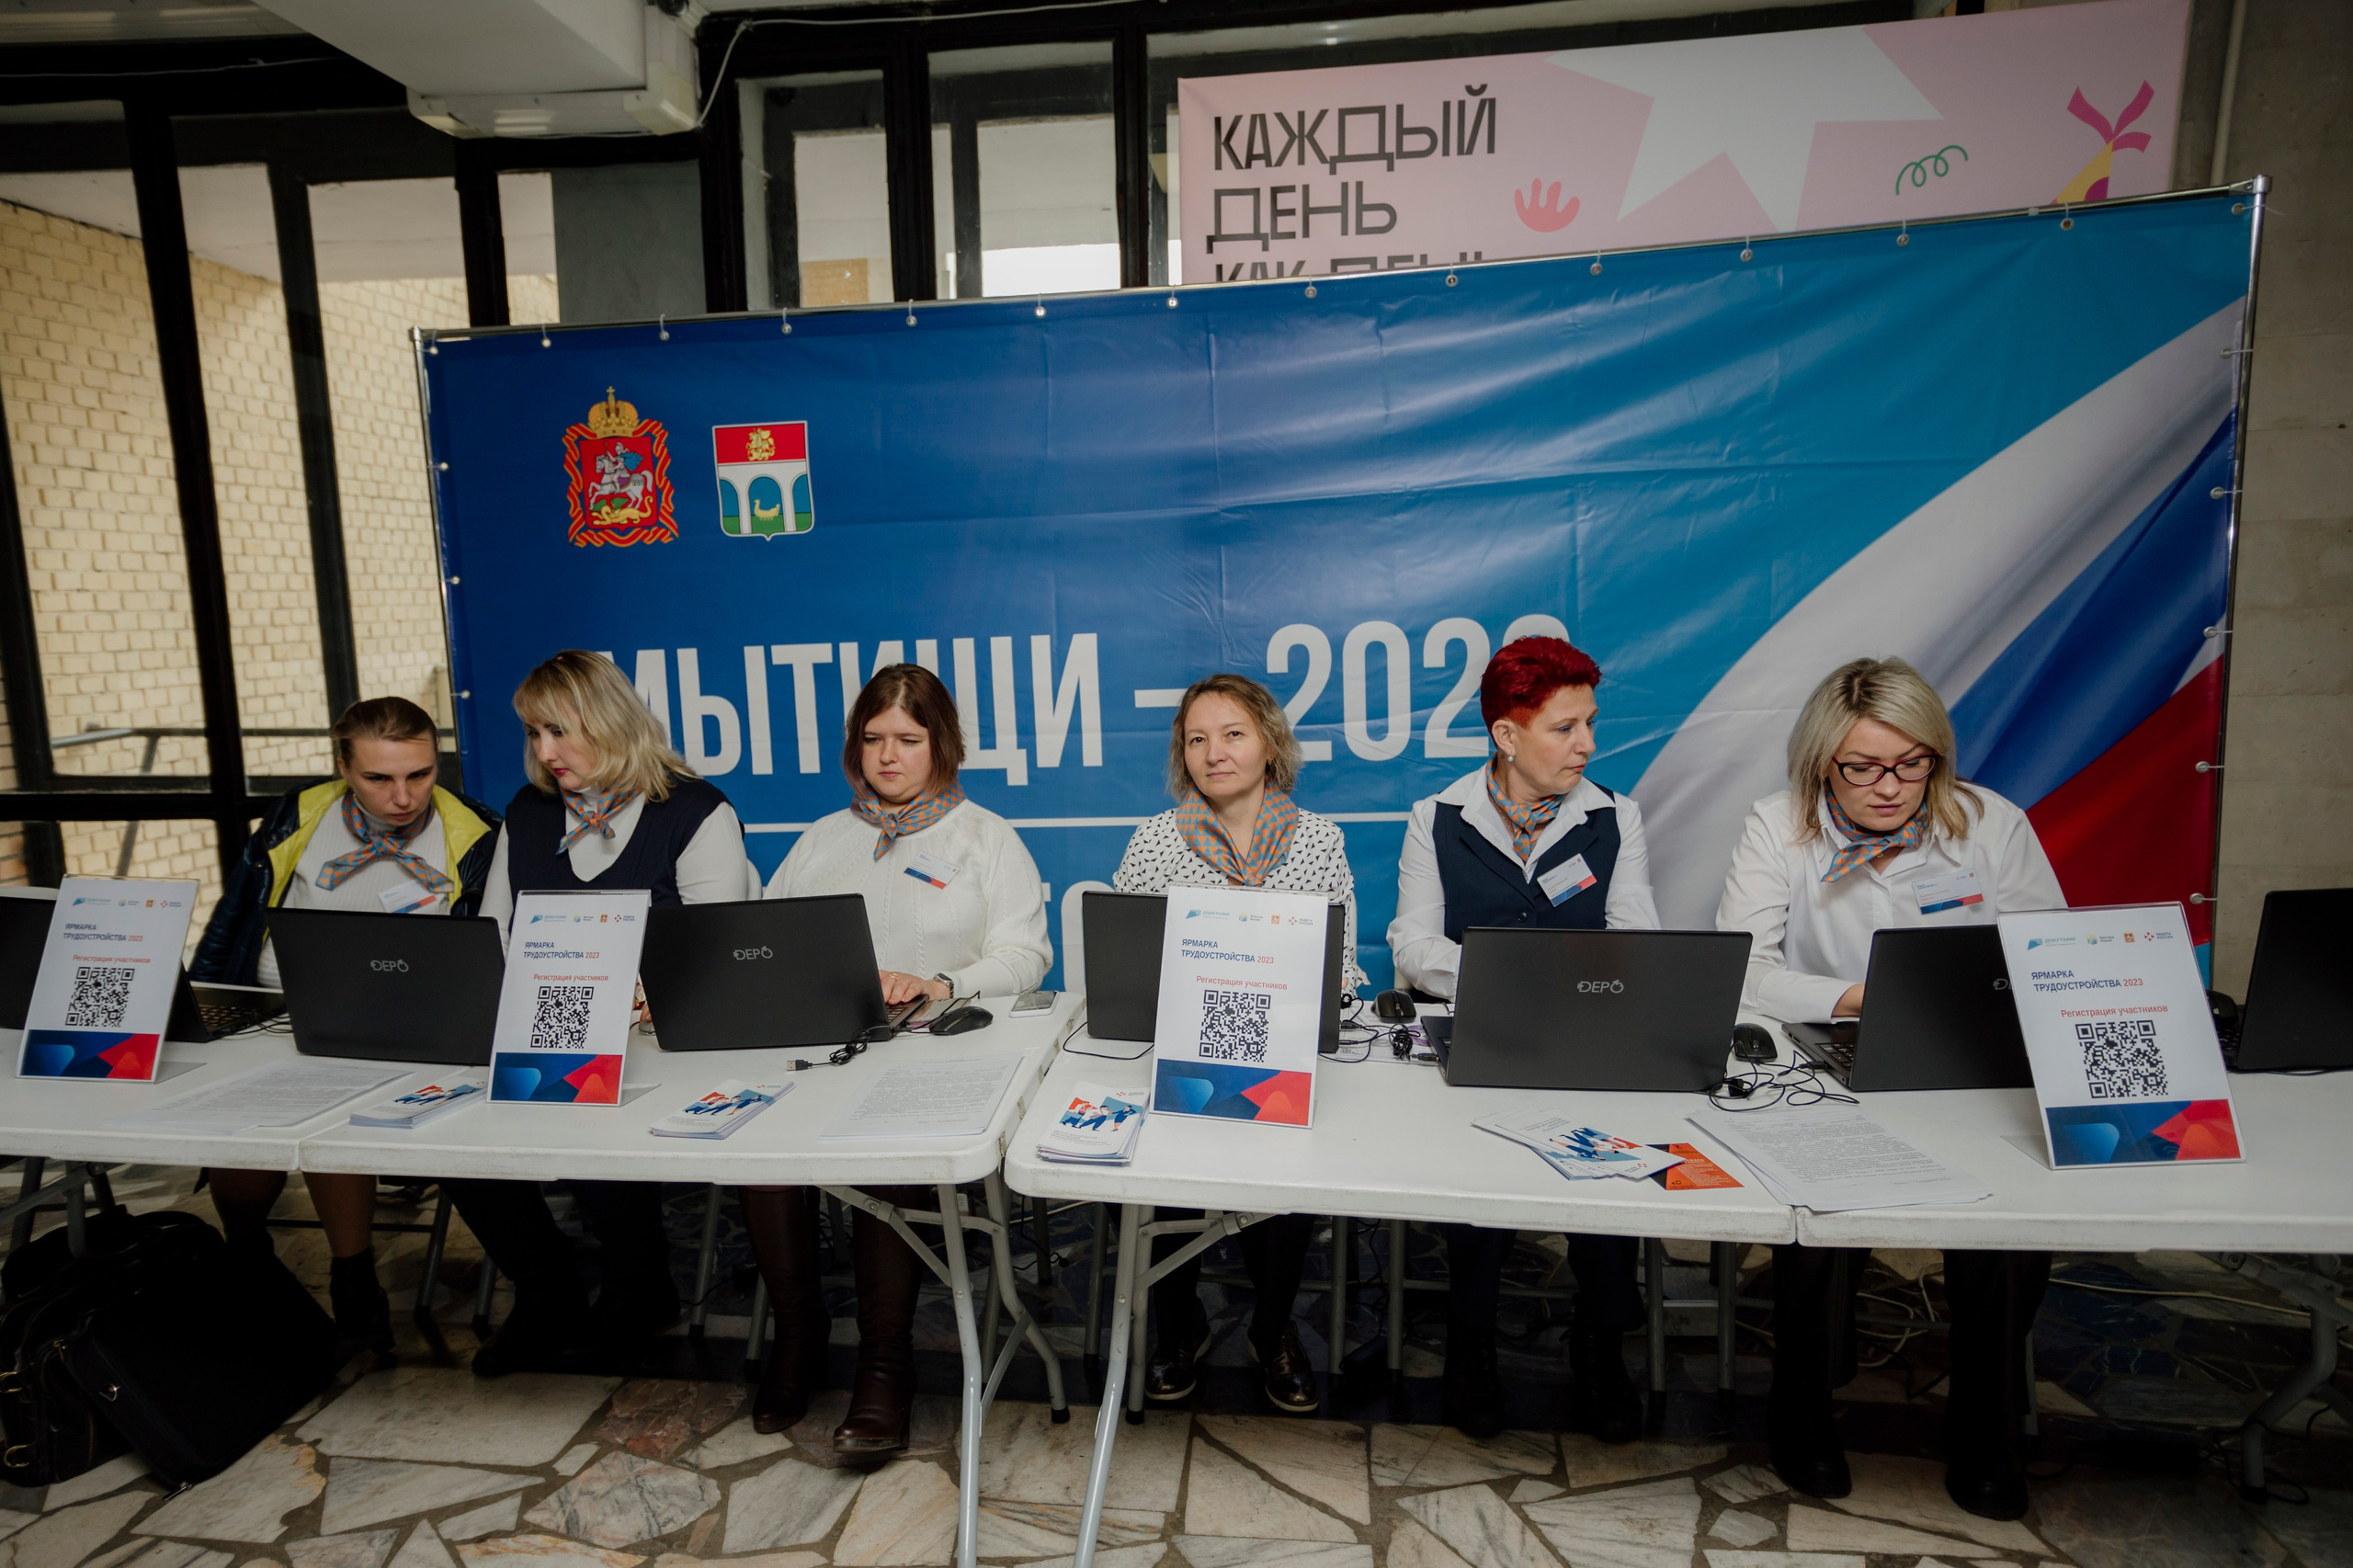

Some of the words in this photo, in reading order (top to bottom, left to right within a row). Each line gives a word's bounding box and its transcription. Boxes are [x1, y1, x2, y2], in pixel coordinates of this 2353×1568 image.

[1214, 84, 1497, 176] КАЖДЫЙ
[1206, 181, 1397, 255] ДЕНЬ
[1266, 613, 1571, 762] 202
[63, 933, 126, 941] ТРУДОУСТРОЙСТВА
[1182, 938, 1218, 949] ЯРМАРКА
[73, 955, 112, 963] Регистрация
[524, 950, 584, 959] ТРУДОУСТРОЙСТВА
[1181, 949, 1255, 962] ТРУДОУСТРОЙСТВА
[1256, 955, 1275, 964] 2023
[1196, 975, 1244, 987] Регистрация
[1245, 980, 1288, 990] участников
[2031, 970, 2075, 981] ЯРМАРКА
[2034, 979, 2121, 993] ТРУДОУСТРОЙСТВА
[2123, 978, 2143, 987] 2023
[2061, 1007, 2117, 1018] Регистрация
[2118, 1005, 2168, 1016] участников
